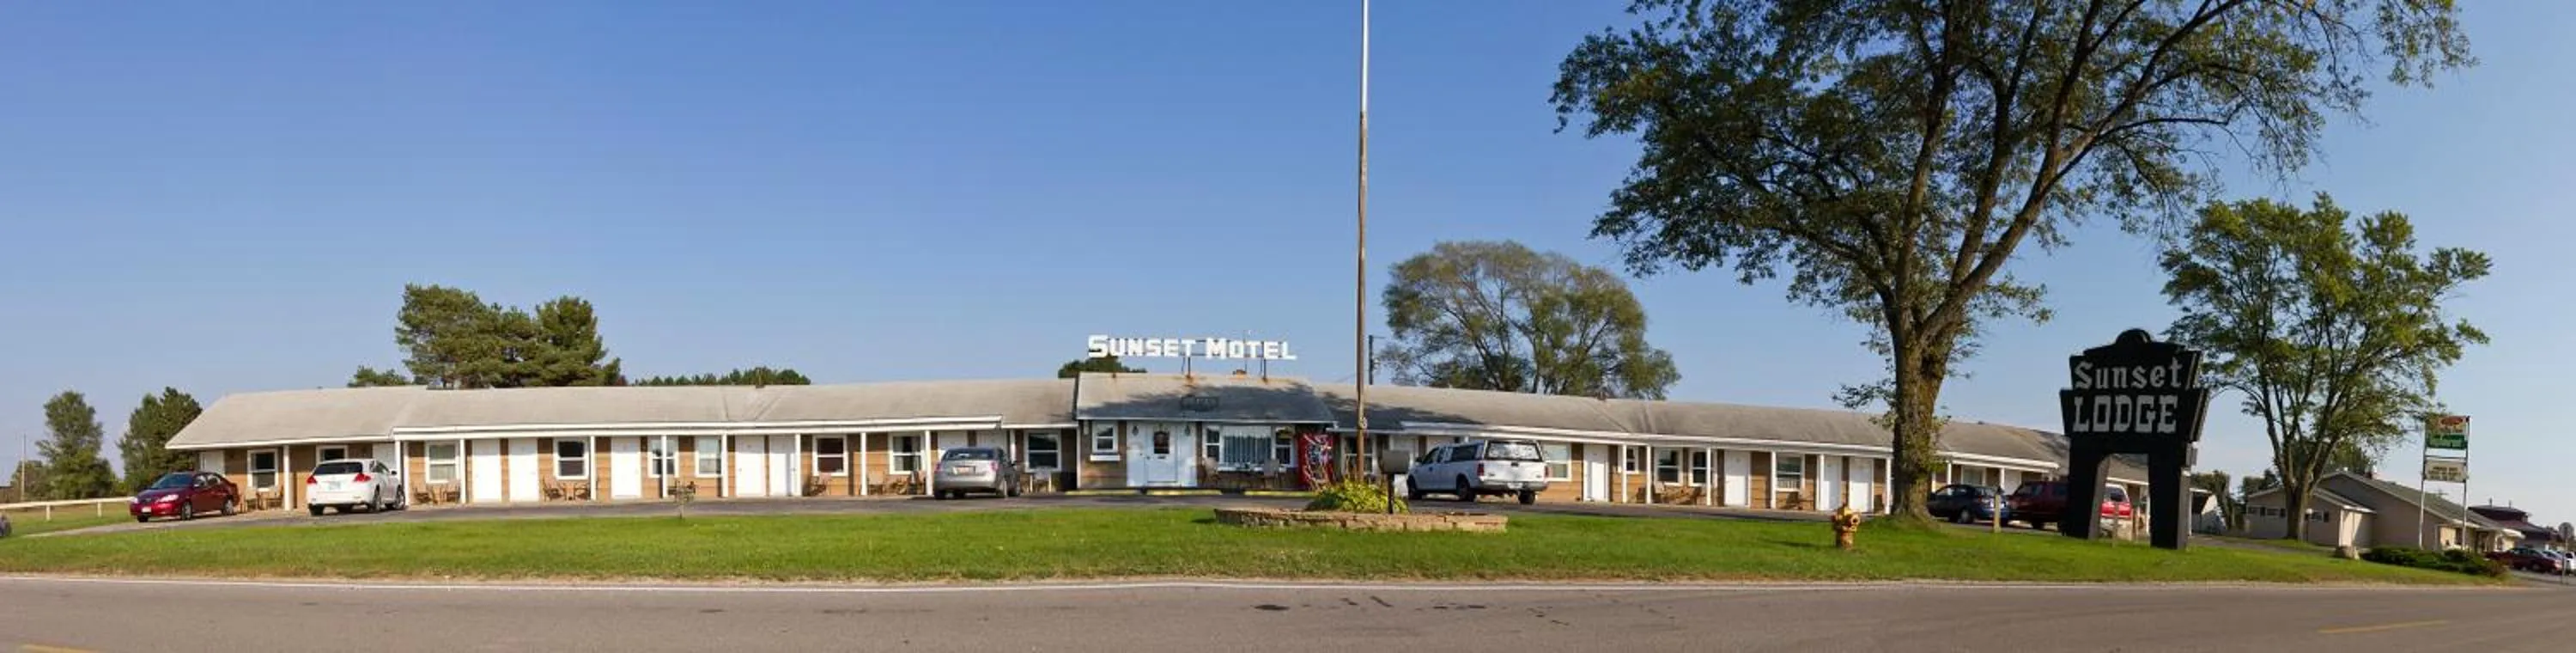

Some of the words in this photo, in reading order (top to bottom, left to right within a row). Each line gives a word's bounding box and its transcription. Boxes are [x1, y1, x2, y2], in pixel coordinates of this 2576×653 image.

[1088, 334, 1196, 358] SUNSET
[1206, 338, 1297, 359] MOTEL
[2074, 357, 2183, 389] Sunset
[2073, 394, 2178, 433] LODGE
